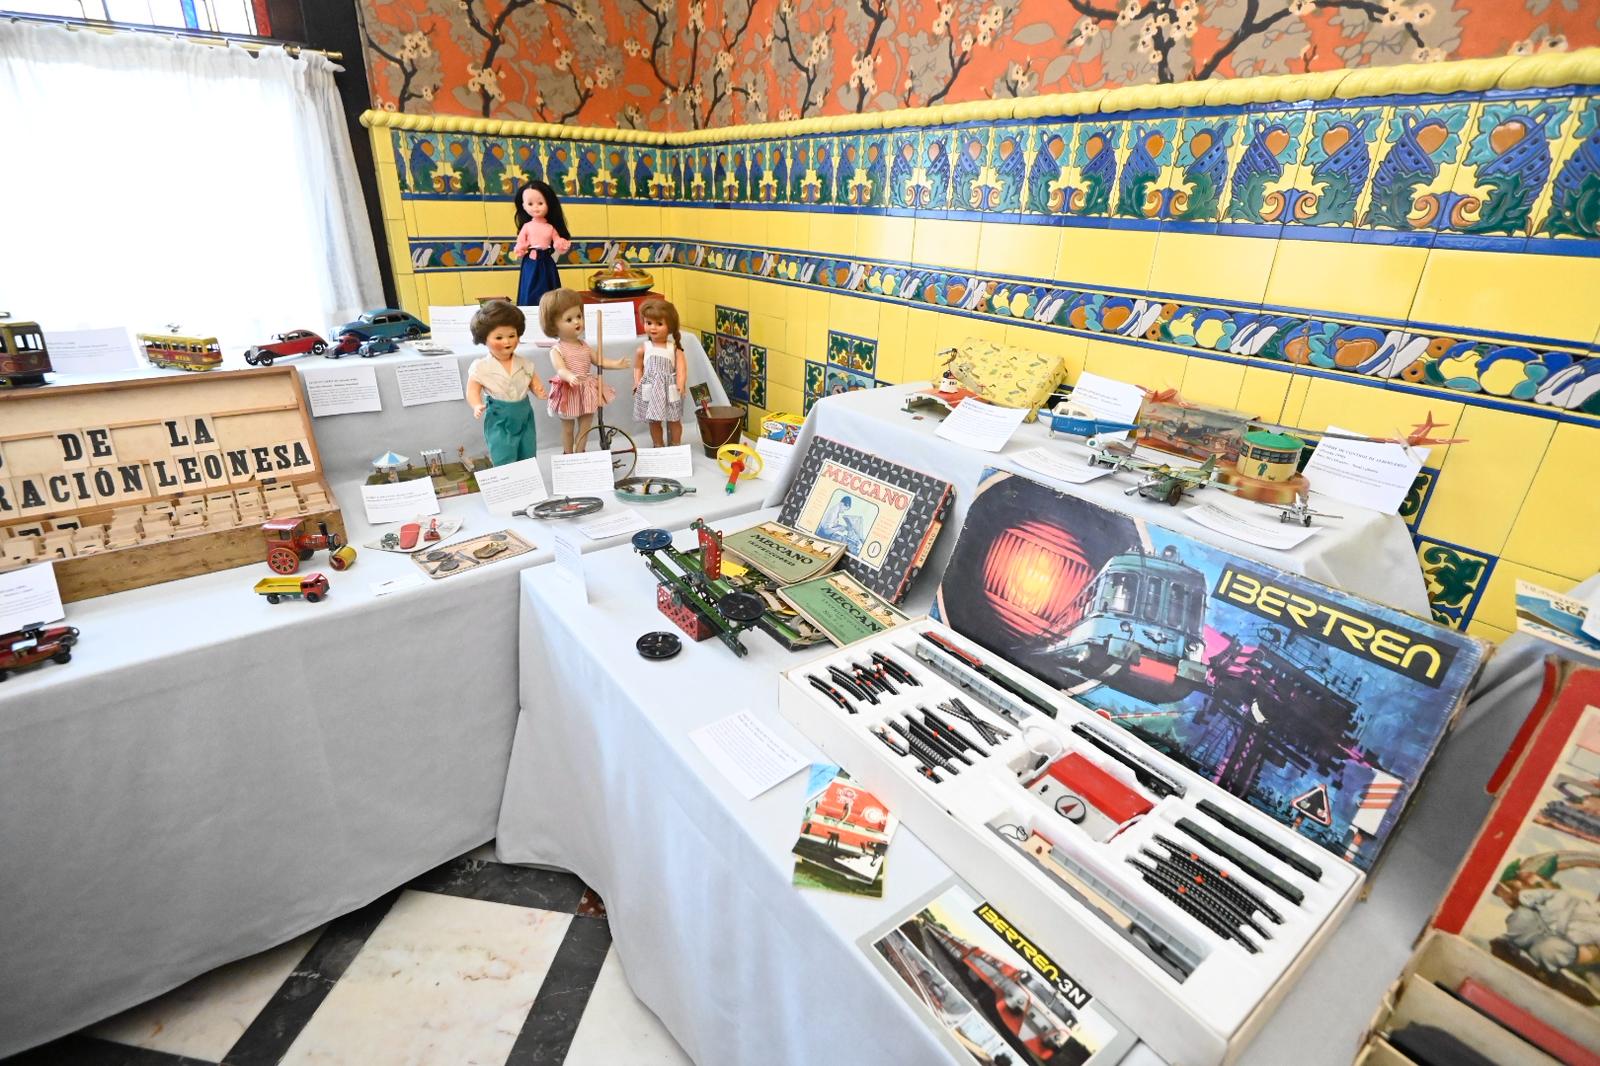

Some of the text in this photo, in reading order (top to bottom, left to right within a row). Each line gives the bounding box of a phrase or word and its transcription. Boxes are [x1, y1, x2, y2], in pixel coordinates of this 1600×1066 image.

[57, 417, 215, 462] DE LA
[153, 442, 311, 488] LEONESA
[821, 464, 909, 511] MECCANO
[750, 533, 814, 565] MECCANO
[820, 587, 883, 632] MECCAN
[1218, 570, 1441, 679] IBERTREN
[978, 905, 1086, 1005] IBERTREN-3N
